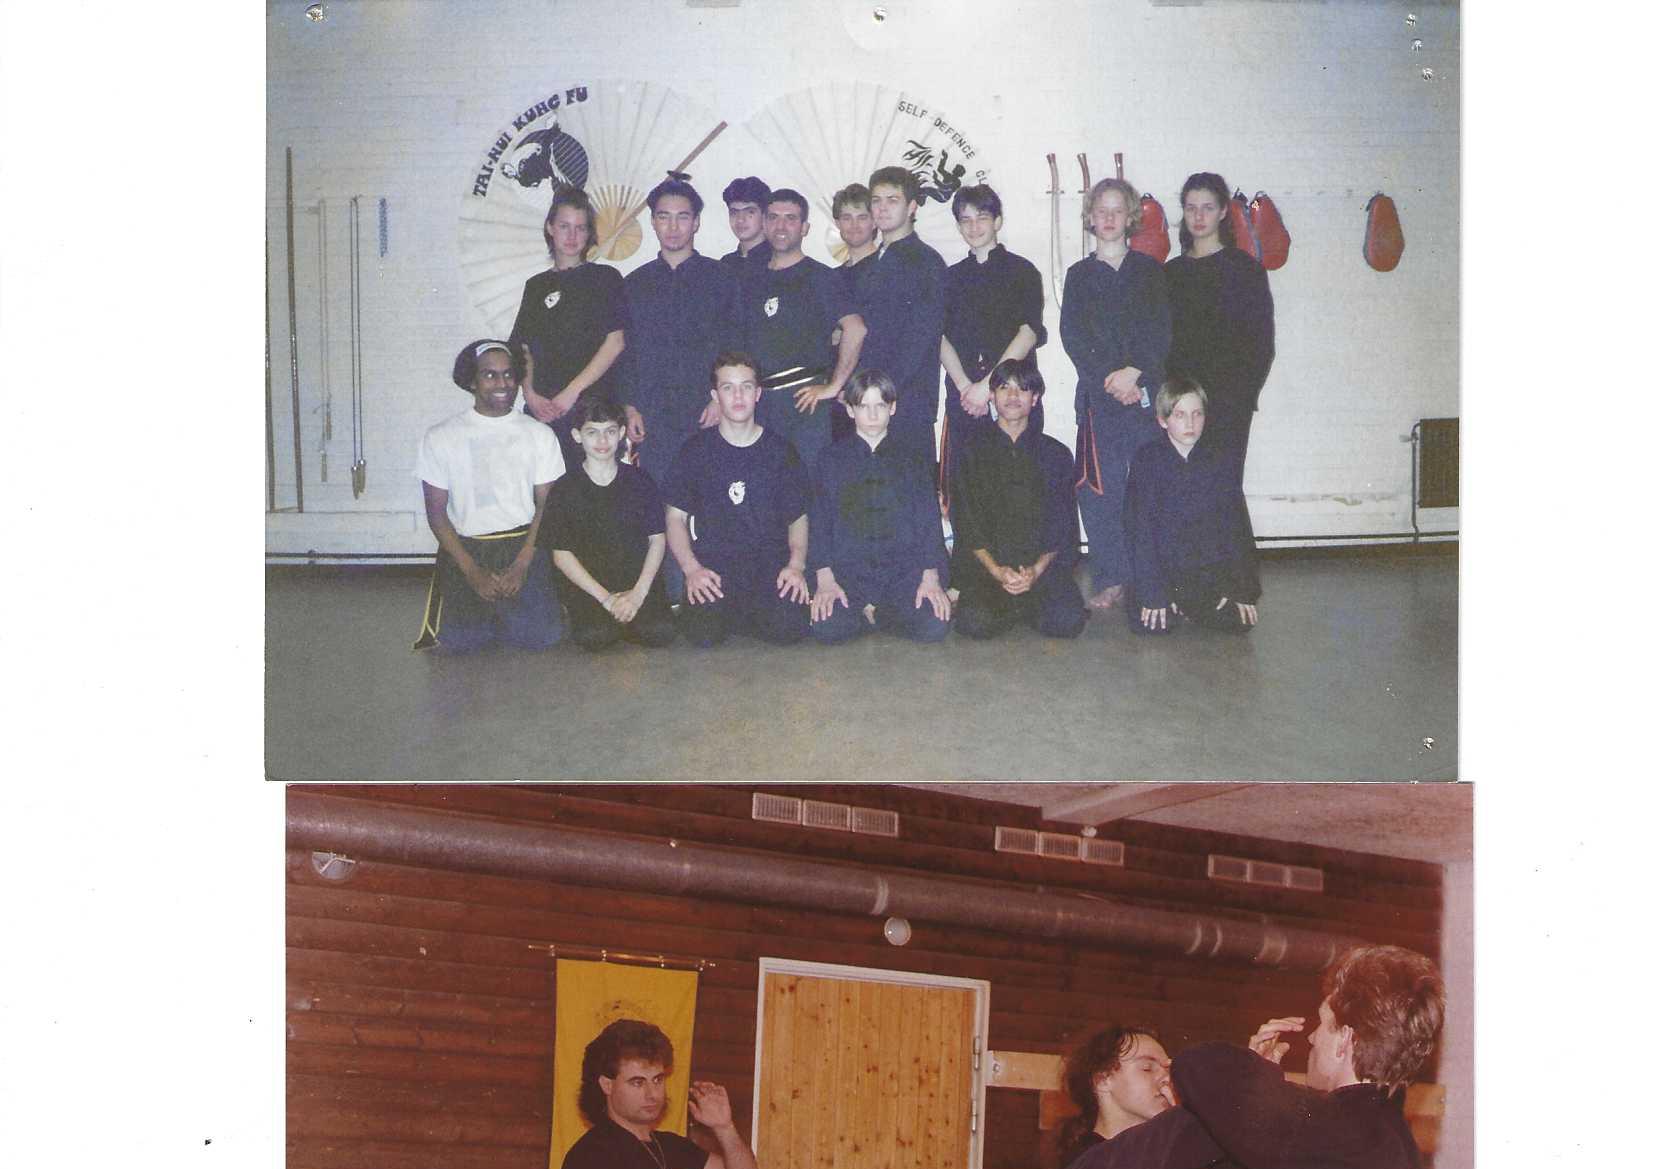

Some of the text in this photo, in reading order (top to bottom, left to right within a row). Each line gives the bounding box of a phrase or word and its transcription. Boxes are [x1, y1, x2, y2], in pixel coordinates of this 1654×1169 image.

[472, 132, 514, 198] TAI-HUI
[565, 86, 588, 105] FU
[897, 100, 928, 119] SELF
[933, 117, 976, 160] DEFENCE
